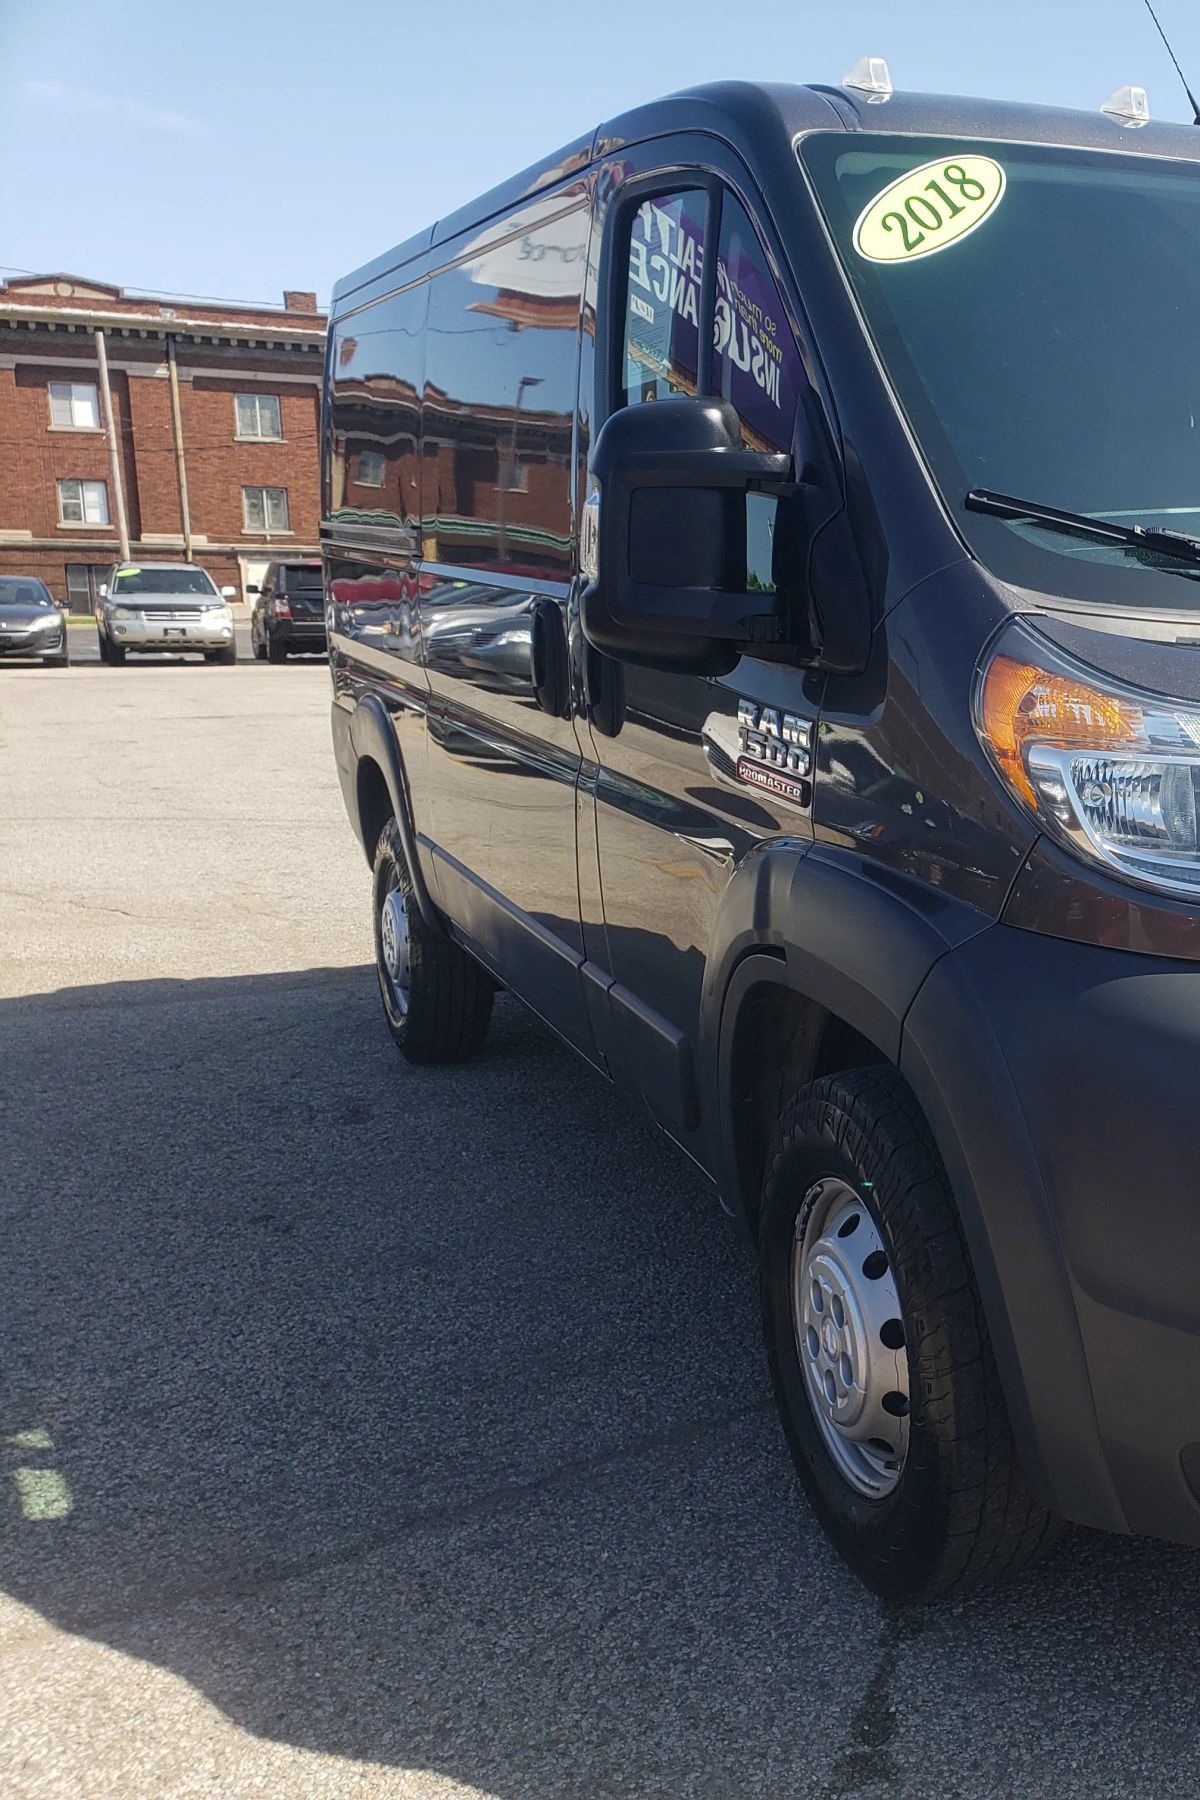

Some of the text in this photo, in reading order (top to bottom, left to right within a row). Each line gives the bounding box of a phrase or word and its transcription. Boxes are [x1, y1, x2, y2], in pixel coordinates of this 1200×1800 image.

[881, 164, 985, 251] 2018
[738, 699, 812, 747] RAM
[738, 726, 811, 777] 1500
[739, 764, 801, 797] PROMASTER
